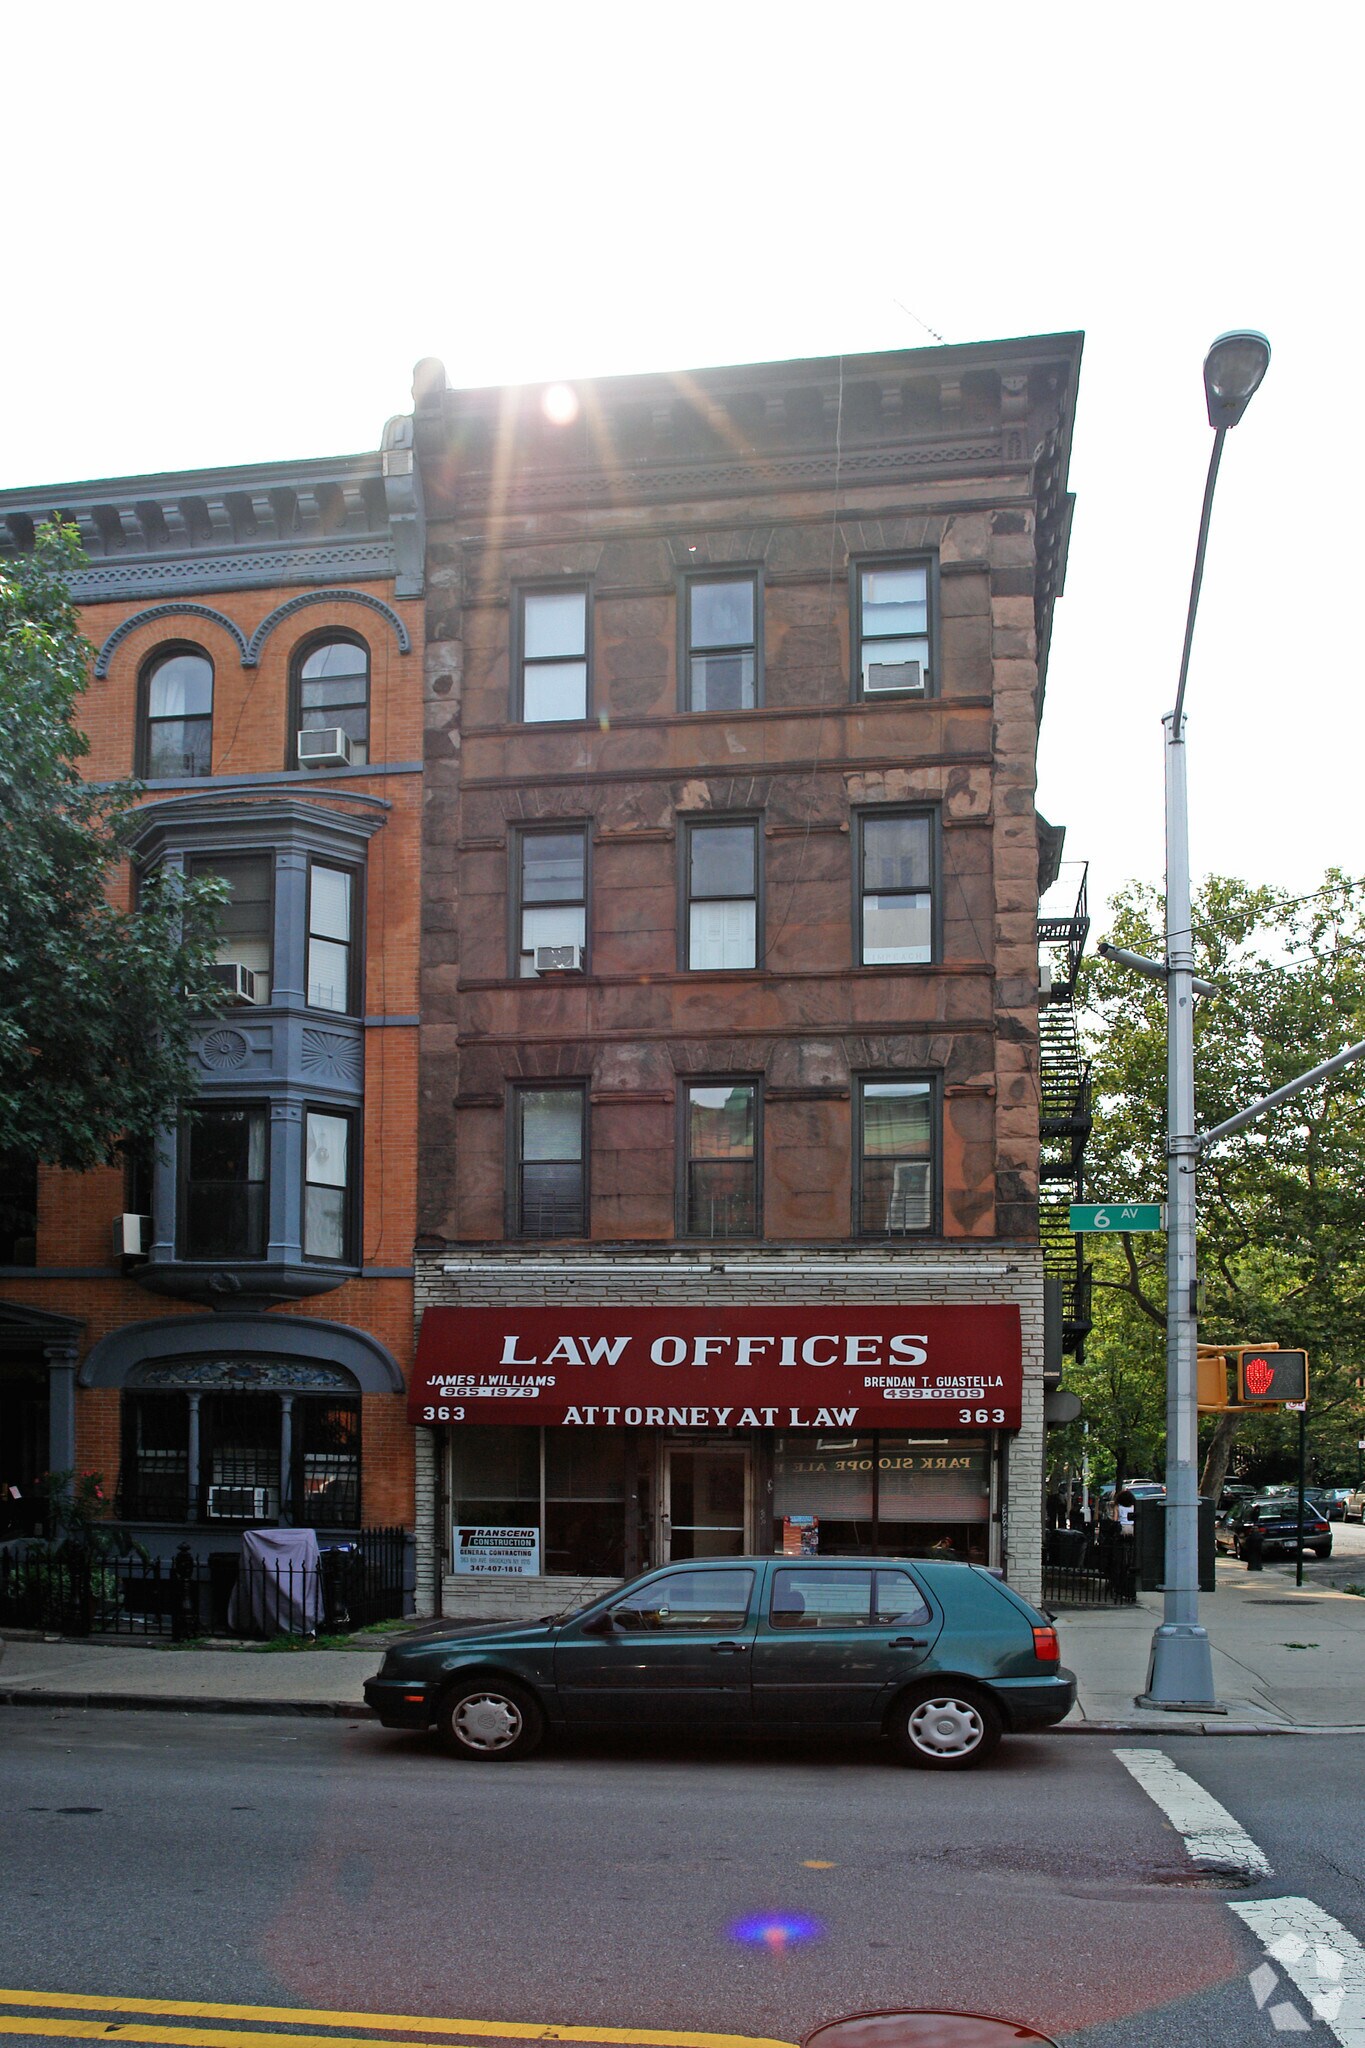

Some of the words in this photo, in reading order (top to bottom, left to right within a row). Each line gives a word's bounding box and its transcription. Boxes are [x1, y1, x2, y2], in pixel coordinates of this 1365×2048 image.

[1094, 1208, 1111, 1228] 6
[1121, 1208, 1138, 1219] AV
[499, 1335, 632, 1366] LAW
[650, 1335, 928, 1367] OFFICES
[426, 1375, 475, 1386] JAMES
[864, 1376, 916, 1388] BRENDAN
[921, 1376, 932, 1388] T.
[936, 1375, 1004, 1388] GUASTELLA
[423, 1406, 465, 1421] 363
[562, 1406, 733, 1426] ATTORNEY
[737, 1407, 779, 1427] AT
[789, 1407, 859, 1427] LAW
[958, 1408, 1005, 1424] 363
[458, 1529, 535, 1547] TRANSCEND
[473, 1538, 532, 1547] CONSTRUCTION
